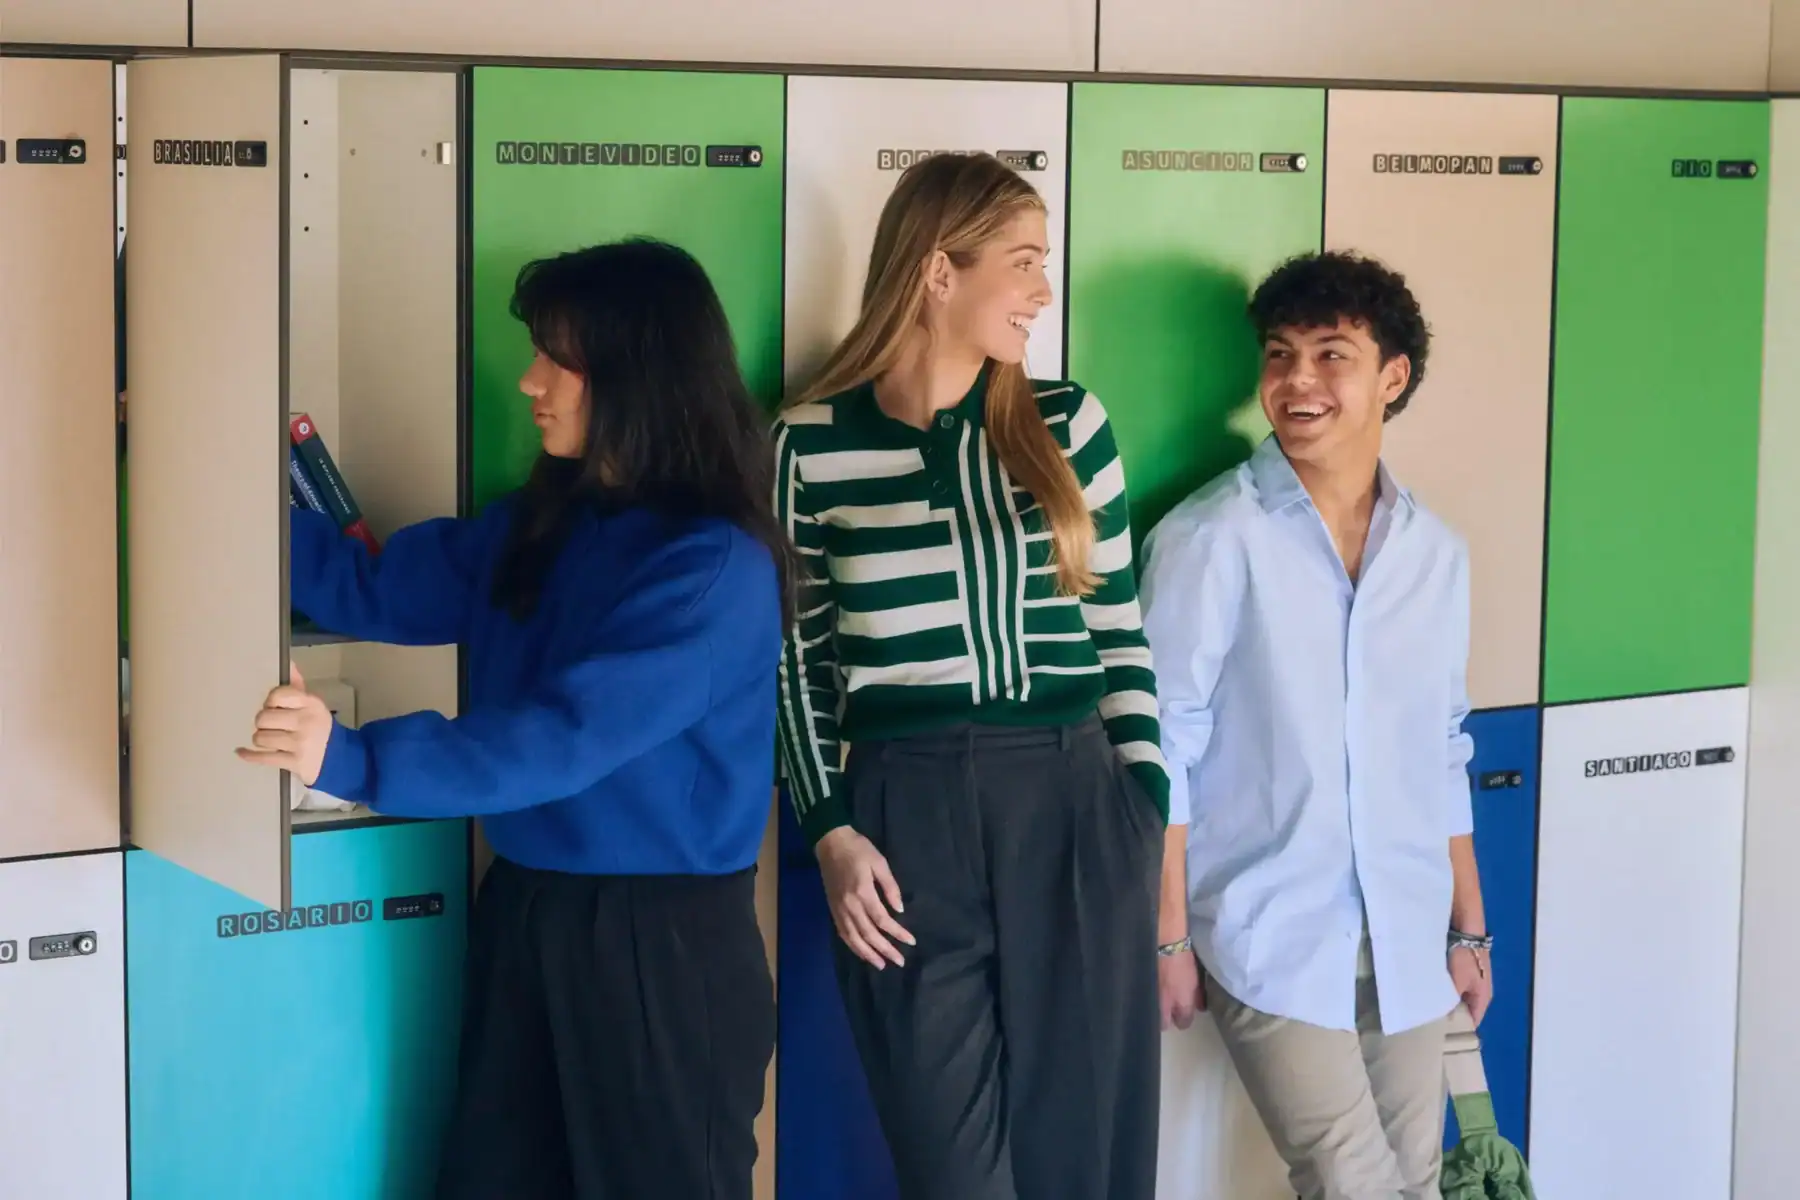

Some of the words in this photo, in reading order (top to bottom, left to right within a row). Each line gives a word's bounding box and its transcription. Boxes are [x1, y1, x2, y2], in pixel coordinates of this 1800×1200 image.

[154, 140, 233, 165] BRASILIA
[498, 143, 699, 165] MONTEVIDEO
[1375, 154, 1491, 173] BELMOPAN
[1673, 160, 1711, 177] RIO
[1586, 751, 1690, 777] SANTIAGO
[219, 901, 370, 936] ROSARIO
